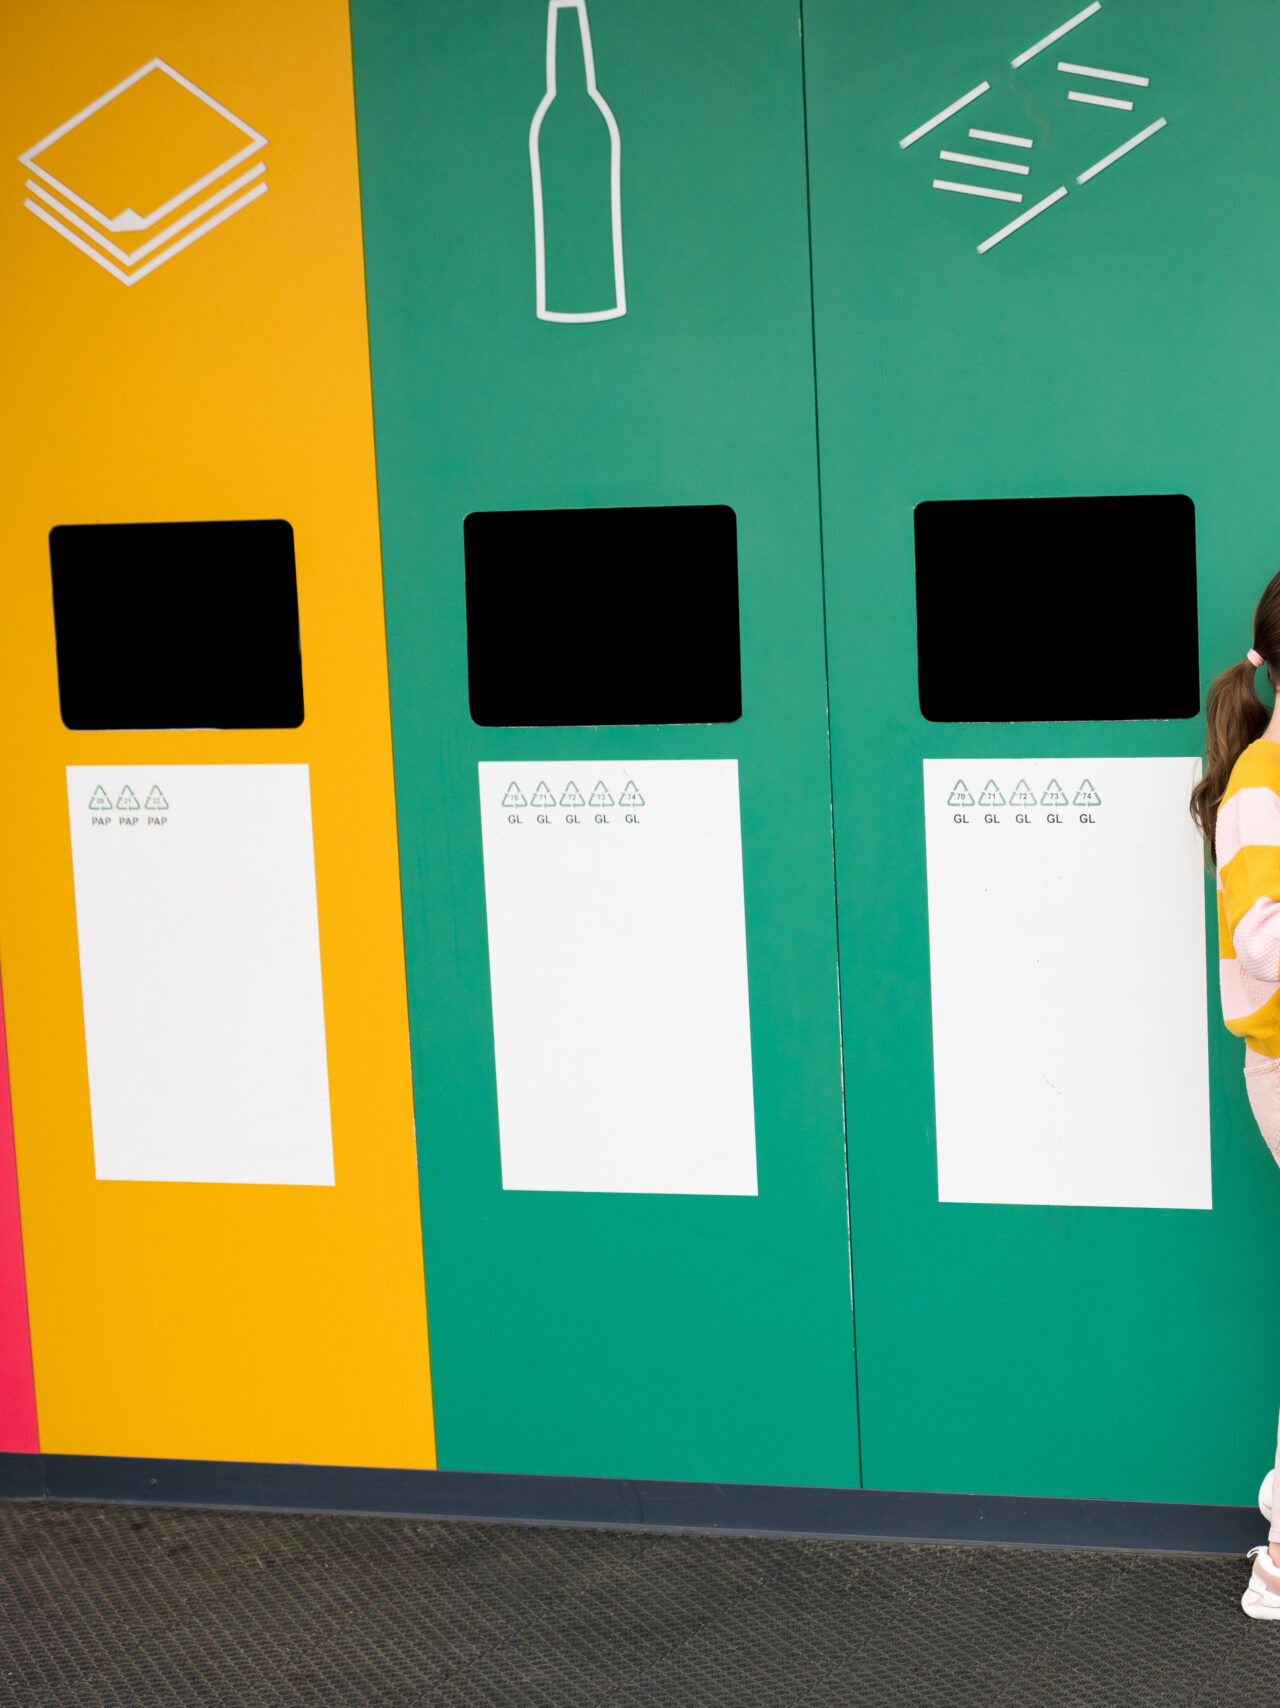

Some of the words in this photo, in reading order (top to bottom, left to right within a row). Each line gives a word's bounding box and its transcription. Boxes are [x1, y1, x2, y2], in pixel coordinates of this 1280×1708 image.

[91, 817, 111, 826] PAP
[119, 817, 139, 826] PAP
[147, 817, 168, 826] PAP
[508, 815, 523, 824] GL
[537, 815, 552, 824] GL
[566, 815, 581, 824] GL
[595, 815, 610, 824] GL
[625, 815, 640, 824] GL
[953, 814, 969, 823] GL
[984, 814, 1000, 823] GL
[1015, 814, 1031, 823] GL
[1047, 814, 1063, 823] GL
[1079, 814, 1095, 823] GL
